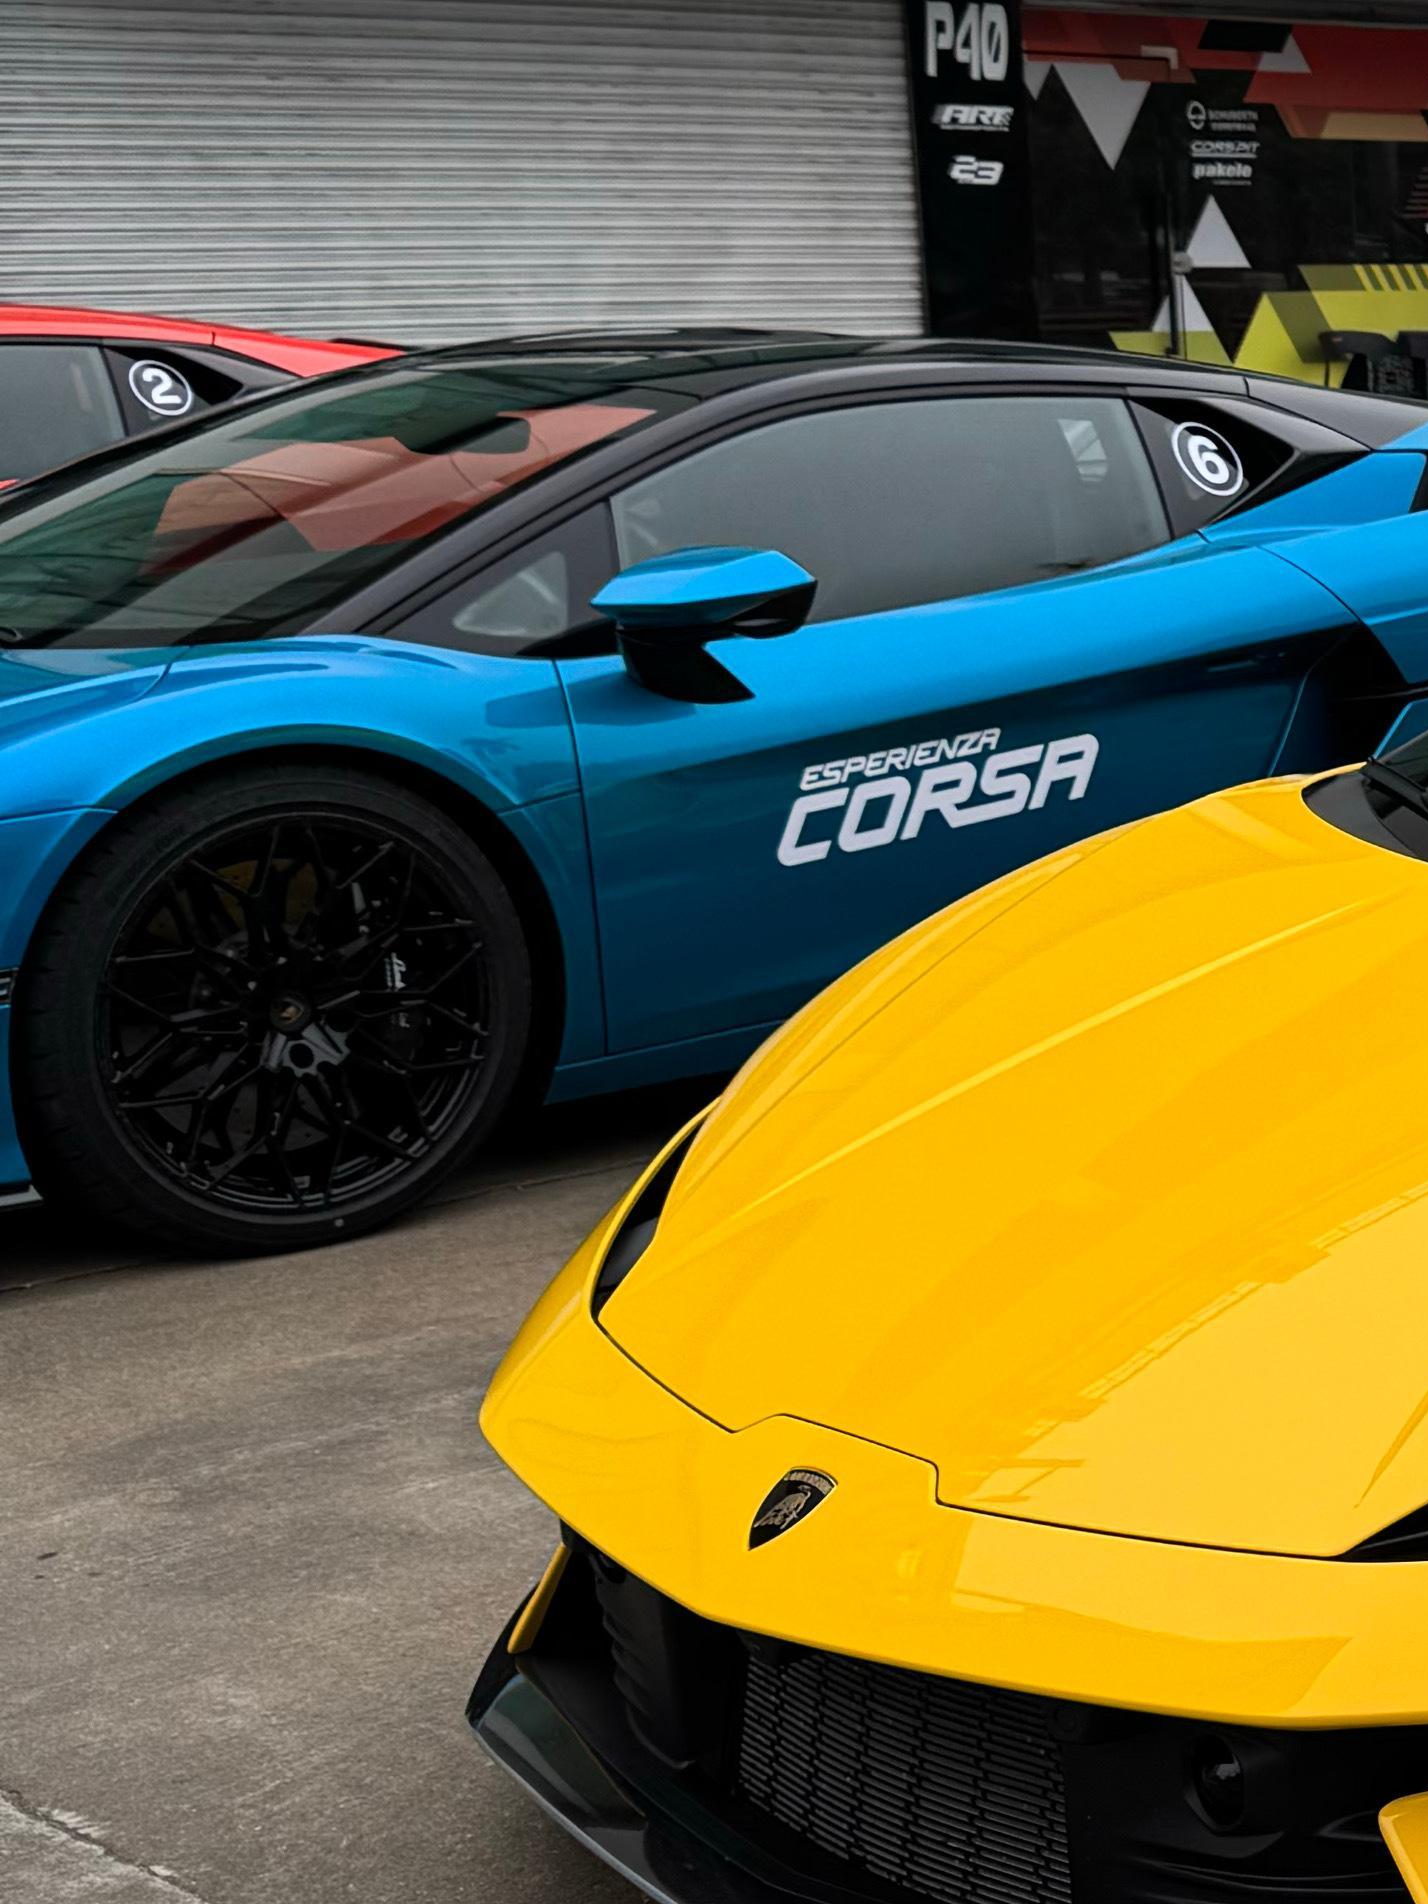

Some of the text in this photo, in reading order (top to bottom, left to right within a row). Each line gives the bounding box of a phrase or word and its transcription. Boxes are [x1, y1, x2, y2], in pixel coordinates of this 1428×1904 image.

[925, 0, 1009, 82] P40
[142, 367, 182, 404] 2
[1187, 435, 1229, 484] 6
[799, 727, 1002, 791] ESPERIENZA
[777, 733, 1100, 867] CORSA
